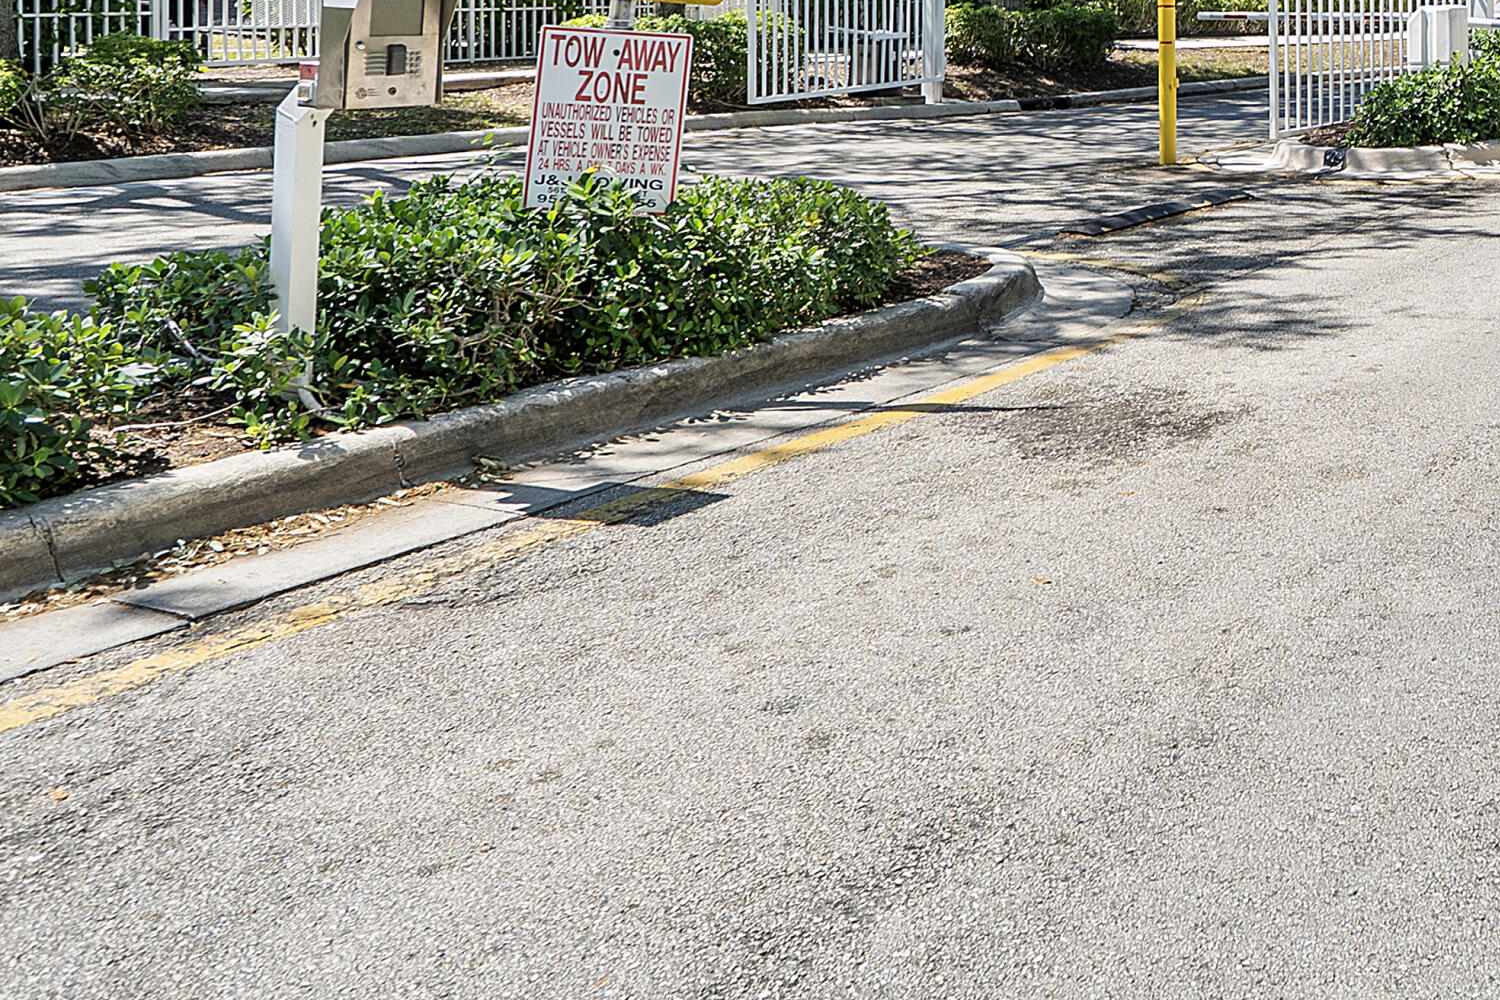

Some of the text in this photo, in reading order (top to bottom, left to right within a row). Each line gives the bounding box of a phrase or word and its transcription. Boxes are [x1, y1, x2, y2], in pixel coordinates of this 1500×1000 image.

[550, 34, 682, 73] TOW AWAY
[575, 70, 648, 104] ZONE
[541, 102, 675, 125] UNAUTHORIZED VEHICLES OR
[541, 121, 672, 143] VESSELS WILL BE TOWED
[538, 140, 671, 162] AT VEHICLE OWNER'S EXPENSE
[538, 158, 549, 170] 24
[553, 160, 573, 171] HRS.
[576, 161, 582, 171] A
[615, 162, 635, 174] DAYS
[640, 165, 646, 174] A
[650, 165, 666, 175] WK.
